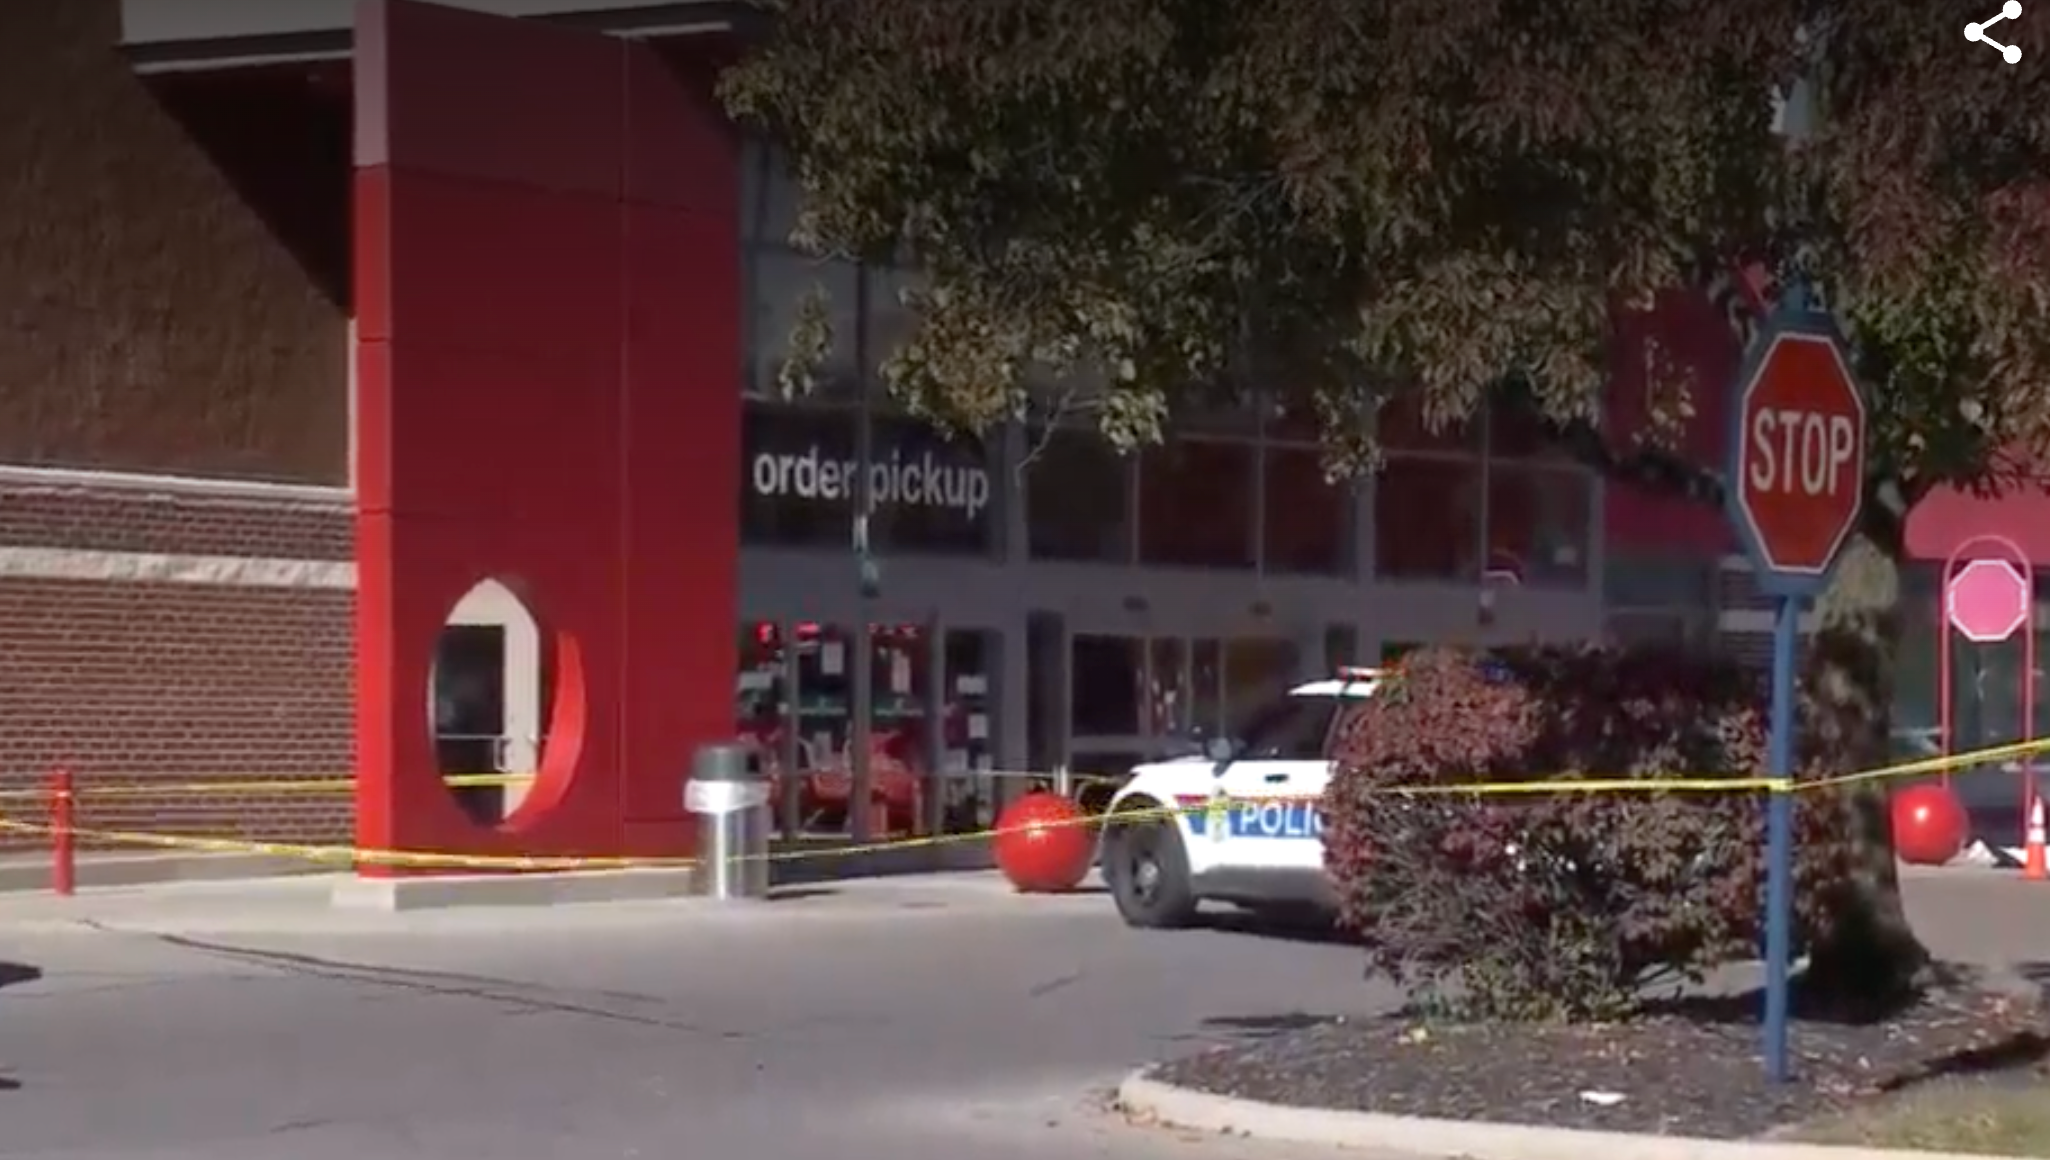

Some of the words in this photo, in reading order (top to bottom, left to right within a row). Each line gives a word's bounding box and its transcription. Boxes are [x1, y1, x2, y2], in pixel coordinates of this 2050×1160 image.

[754, 446, 857, 498] order
[868, 449, 989, 519] pickup
[1750, 407, 1854, 495] STOP
